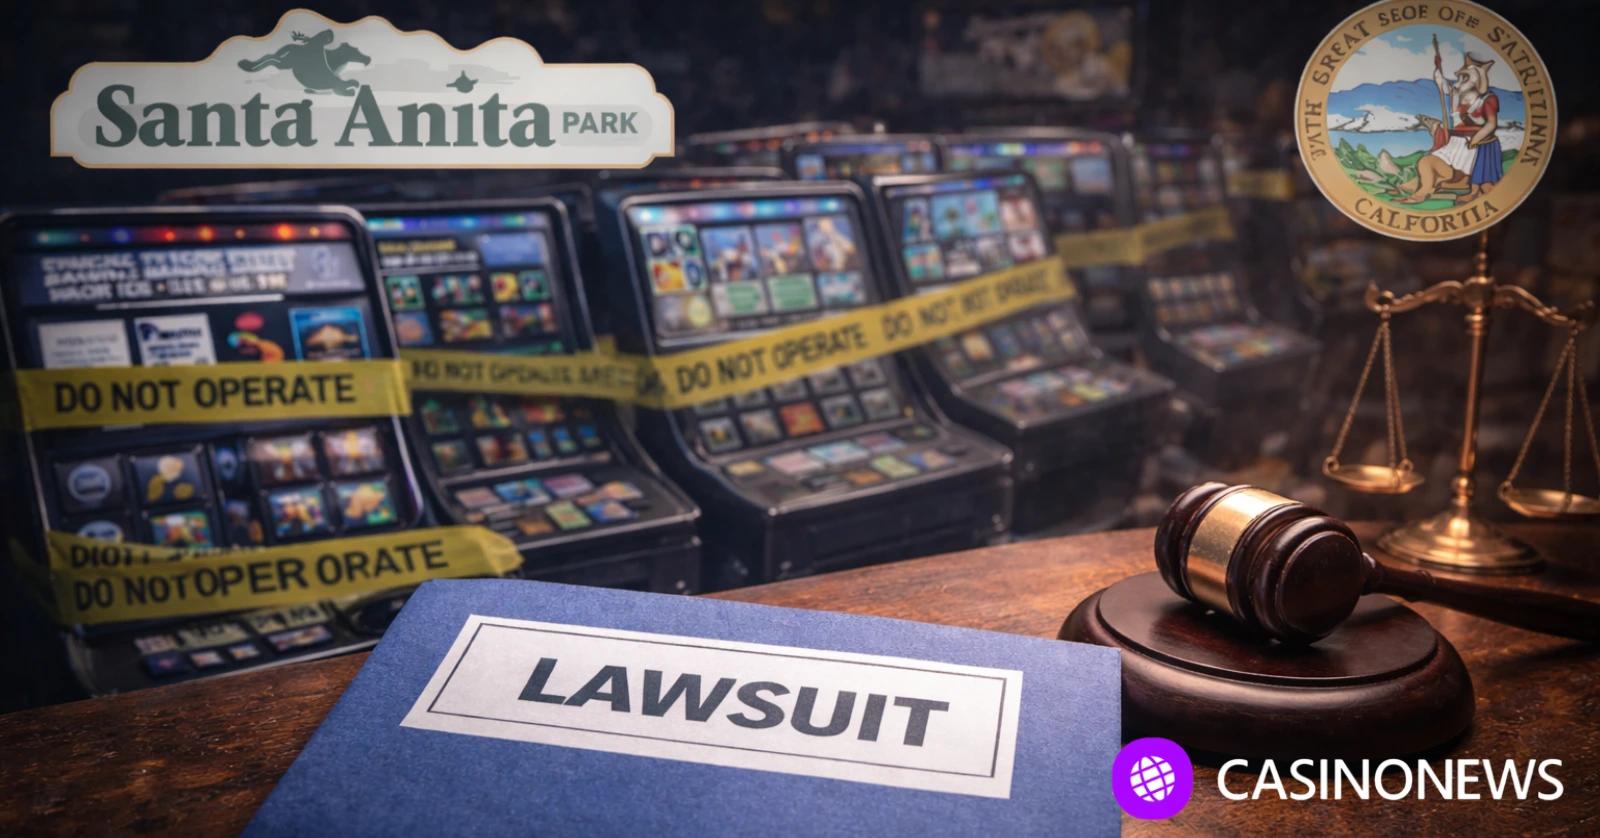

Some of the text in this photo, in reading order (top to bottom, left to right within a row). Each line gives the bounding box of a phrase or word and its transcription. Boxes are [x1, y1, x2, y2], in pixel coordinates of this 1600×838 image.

[95, 84, 639, 149] Santa Anita PARK
[54, 373, 357, 414] DO NOT OPERATE
[676, 361, 712, 395] DO
[717, 346, 767, 385] NOT
[772, 322, 868, 371] OPERATE
[73, 577, 115, 612] DO
[315, 539, 449, 588] ORATE
[518, 657, 950, 748] LAWSUIT
